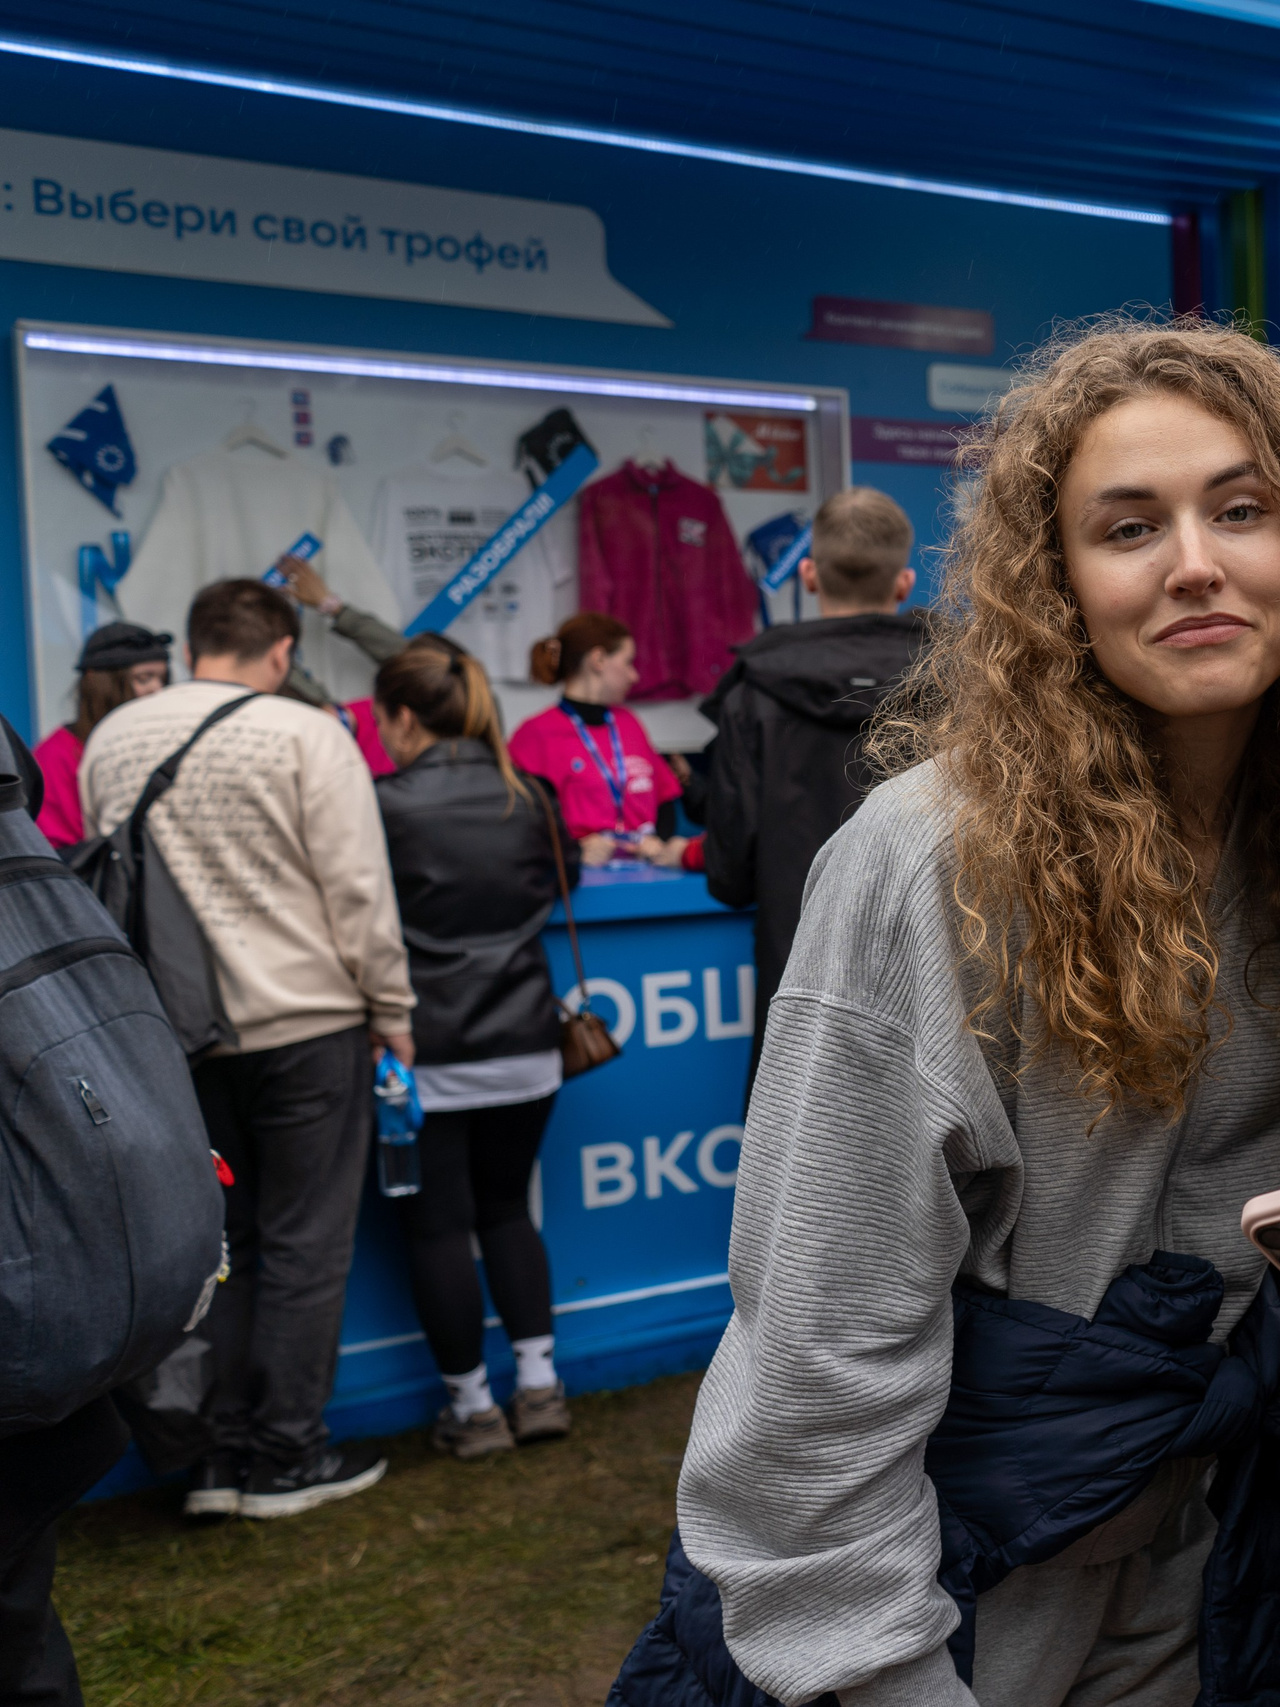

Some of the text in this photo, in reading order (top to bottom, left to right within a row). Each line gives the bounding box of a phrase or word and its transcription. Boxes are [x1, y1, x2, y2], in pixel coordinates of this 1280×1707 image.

[33, 177, 238, 240] Выбери
[253, 212, 368, 251] свой
[379, 226, 549, 275] трофей
[448, 493, 555, 605] РАЗОБРАЛИ
